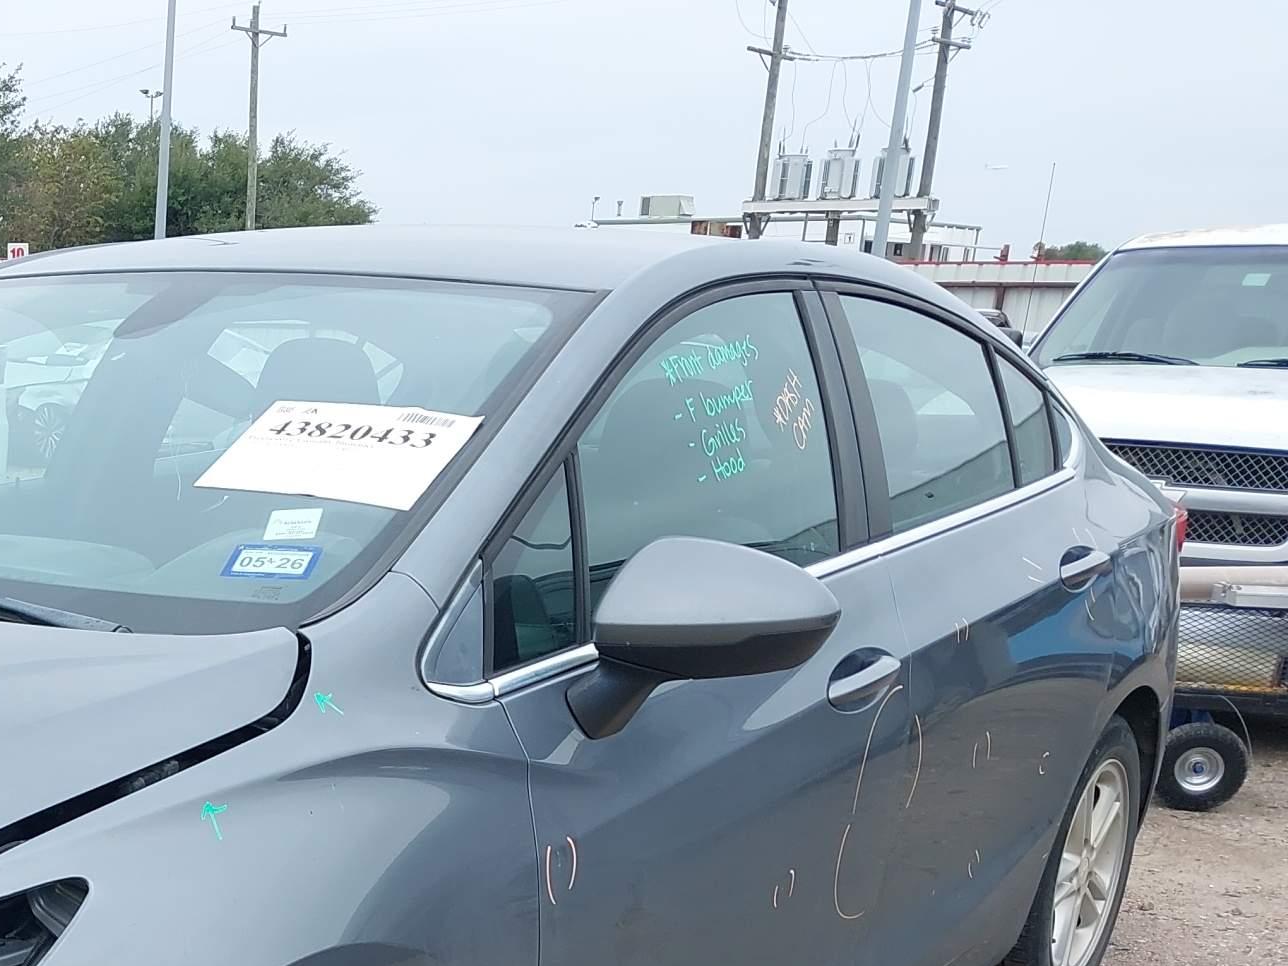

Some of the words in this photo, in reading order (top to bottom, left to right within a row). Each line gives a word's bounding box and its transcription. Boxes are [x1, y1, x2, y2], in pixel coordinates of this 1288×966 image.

[705, 334, 759, 370] damages
[685, 397, 696, 423] F
[699, 380, 753, 417] bumper
[269, 419, 438, 449] 43820433
[701, 418, 746, 457] Grilles
[793, 398, 815, 450] CAM
[711, 447, 746, 482] Hood
[239, 556, 268, 568] 05
[275, 557, 305, 570] 26
